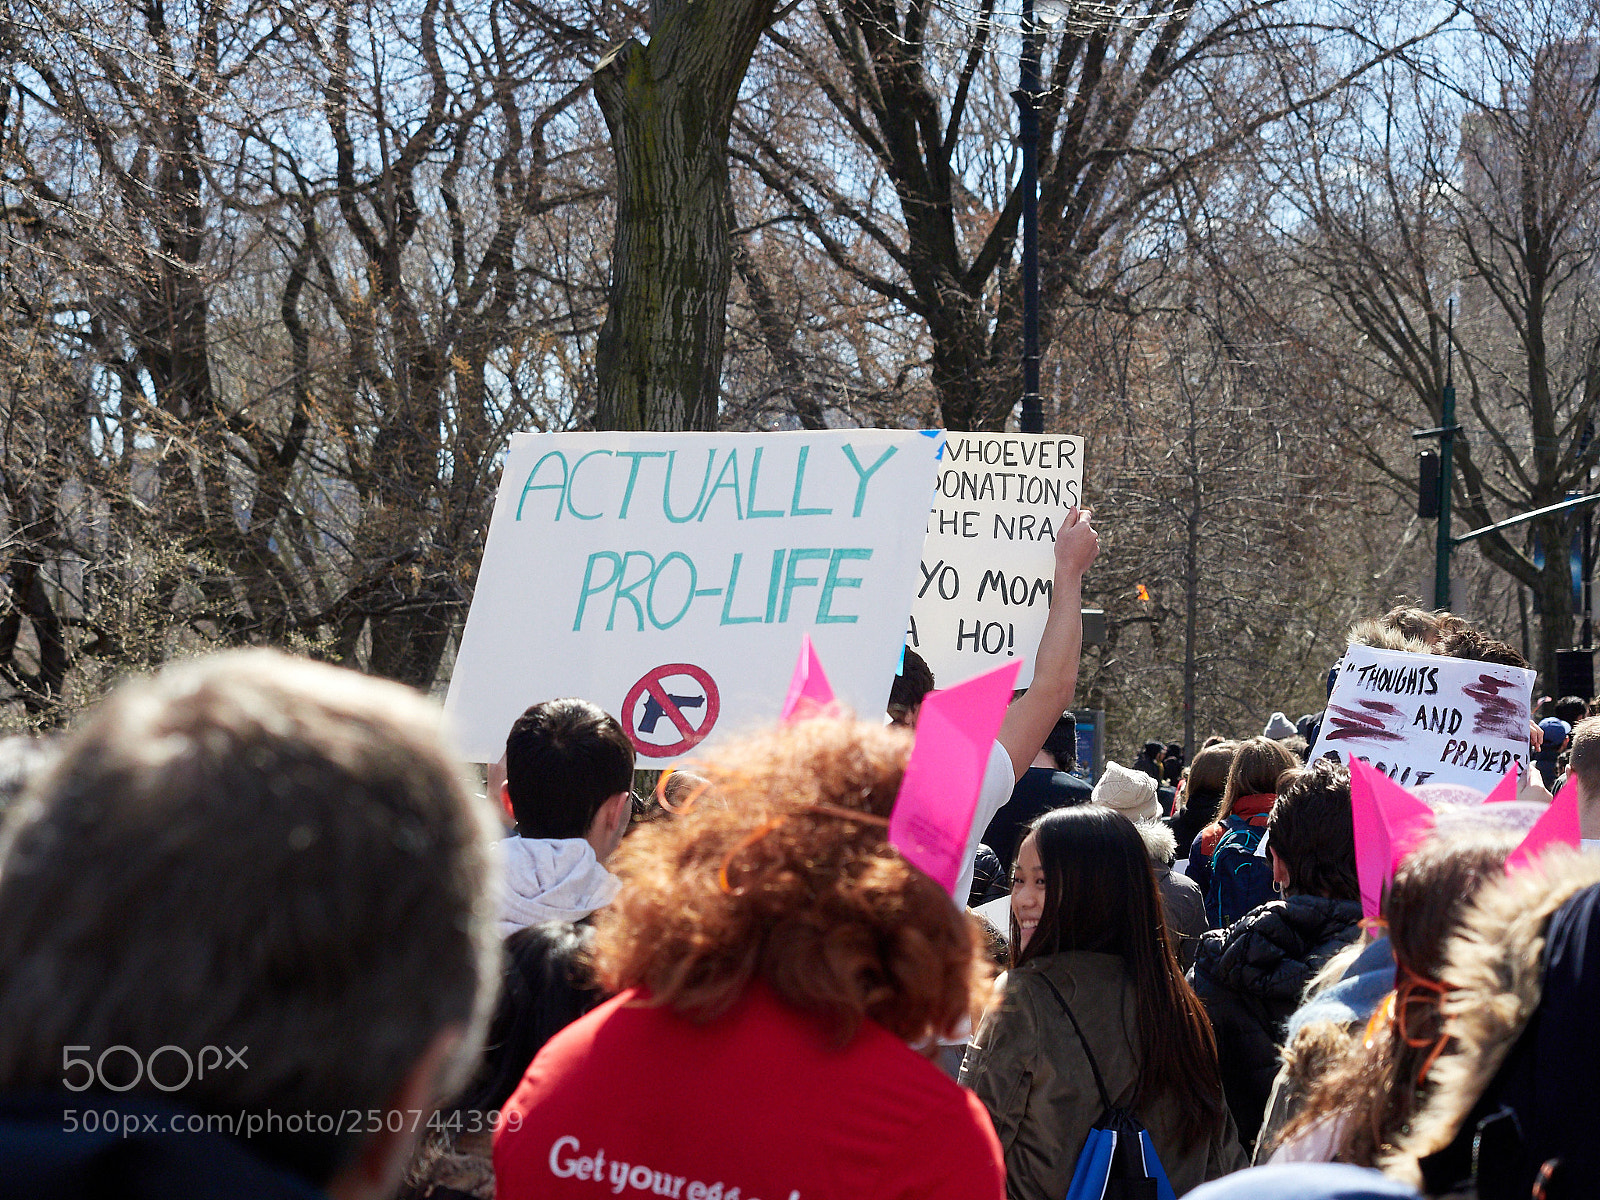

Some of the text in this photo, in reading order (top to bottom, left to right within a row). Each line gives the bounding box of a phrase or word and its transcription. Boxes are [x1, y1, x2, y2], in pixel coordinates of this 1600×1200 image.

[515, 444, 899, 524] ACTUALLY
[572, 547, 874, 632] PRO-LIFE
[956, 618, 1014, 657] HO!
[1412, 704, 1463, 735] AND
[549, 1135, 606, 1182] Get
[610, 1159, 686, 1200] your
